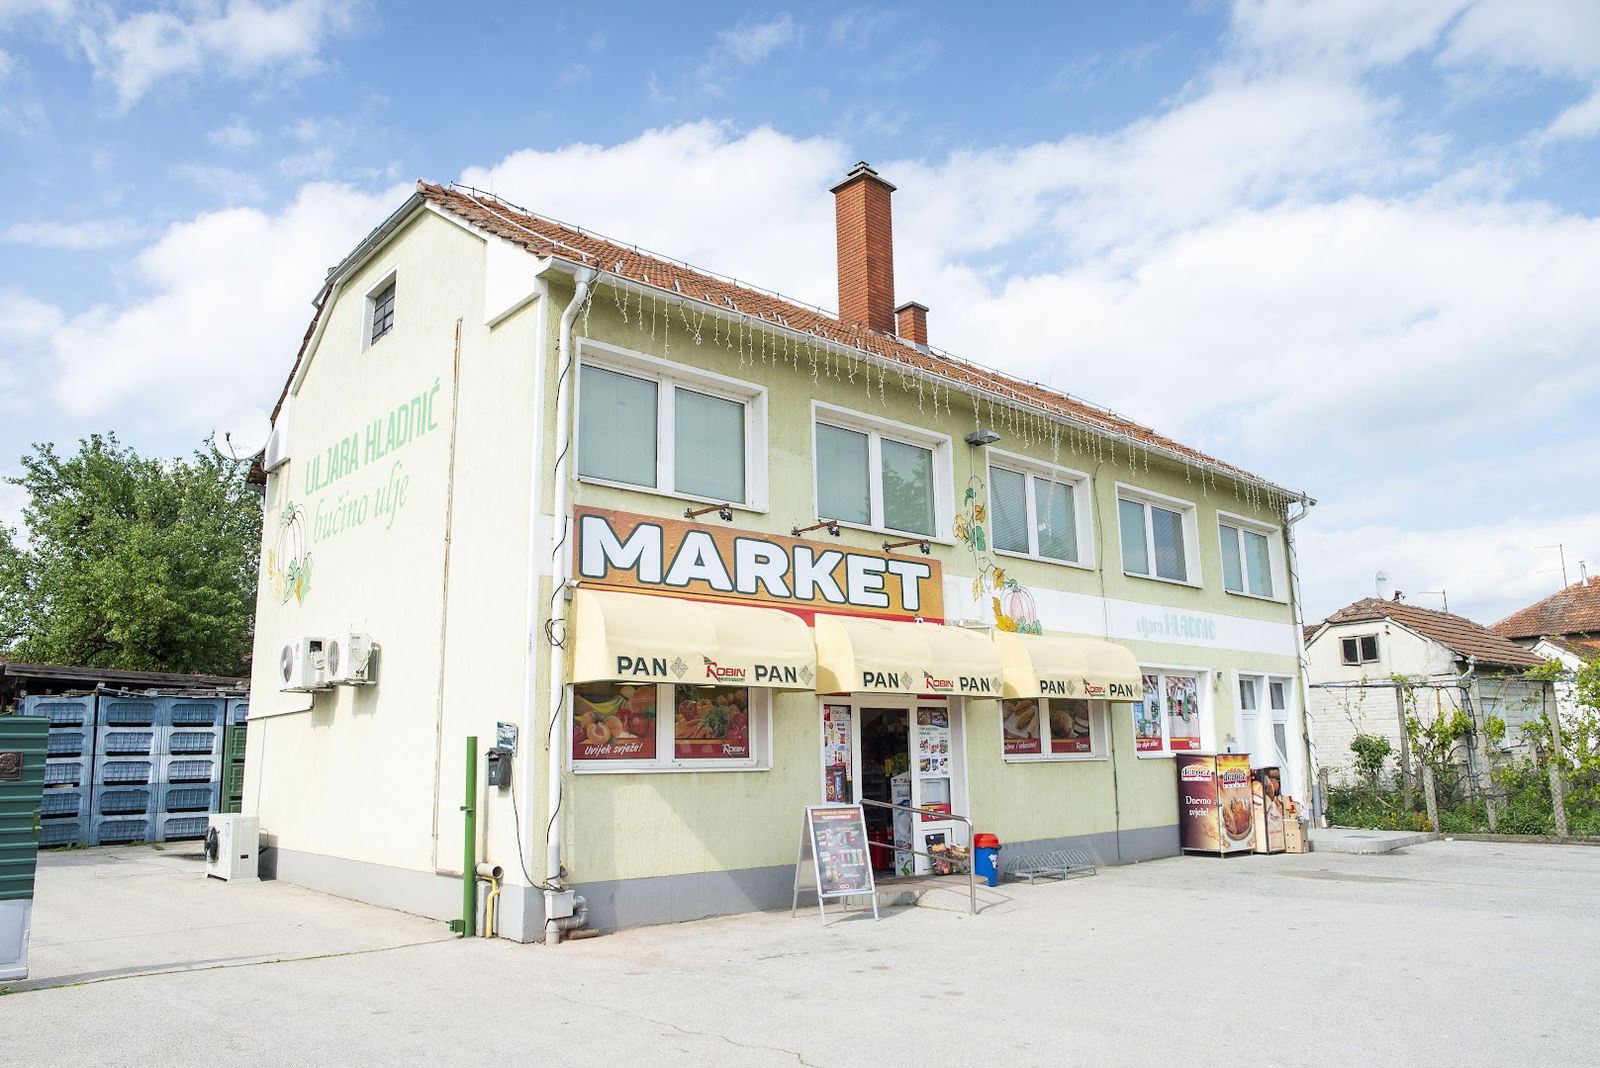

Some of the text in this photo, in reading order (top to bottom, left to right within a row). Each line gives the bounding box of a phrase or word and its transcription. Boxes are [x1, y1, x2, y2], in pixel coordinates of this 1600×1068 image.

[305, 376, 440, 495] ULJARA HLADNIĆ
[314, 460, 409, 543] bučino ulje
[579, 513, 931, 611] MARKET
[617, 656, 798, 683] PAN ROBIN PAN
[863, 671, 991, 692] PAN ROBIN PAN
[1040, 680, 1133, 697] PAN ROBIN PAN
[585, 742, 643, 756] Uvijek svježe!
[1185, 795, 1212, 805] Dnevno
[1188, 807, 1209, 818] svježe!
